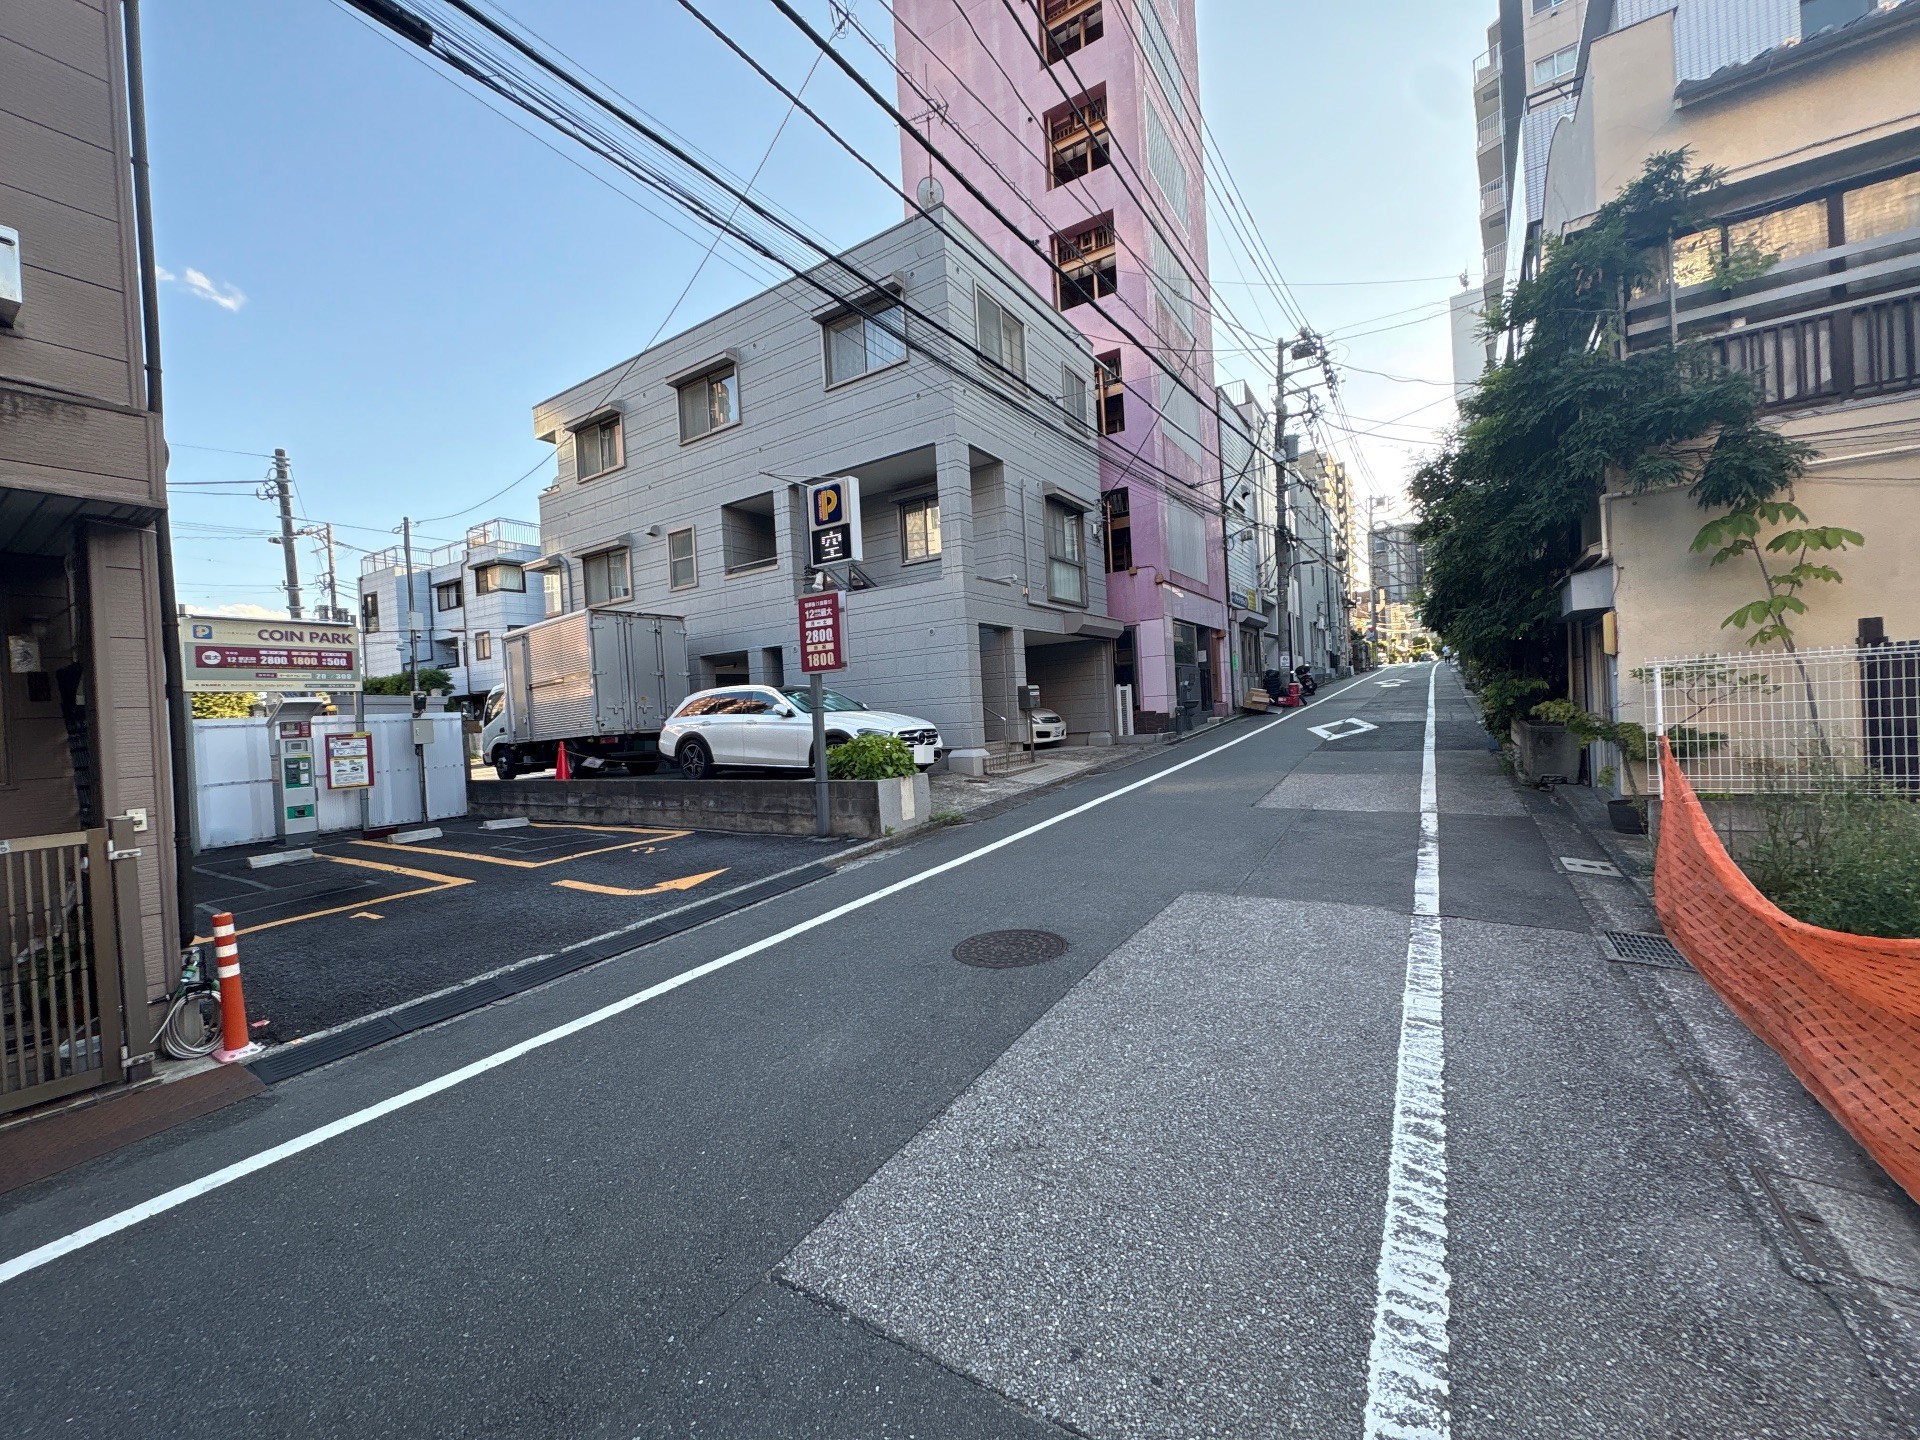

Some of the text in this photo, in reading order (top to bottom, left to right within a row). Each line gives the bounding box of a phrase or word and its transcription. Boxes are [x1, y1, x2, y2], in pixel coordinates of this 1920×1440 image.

[821, 489, 838, 521] P
[821, 531, 843, 559] 空
[257, 629, 304, 642] COIN
[309, 631, 354, 645] PARK
